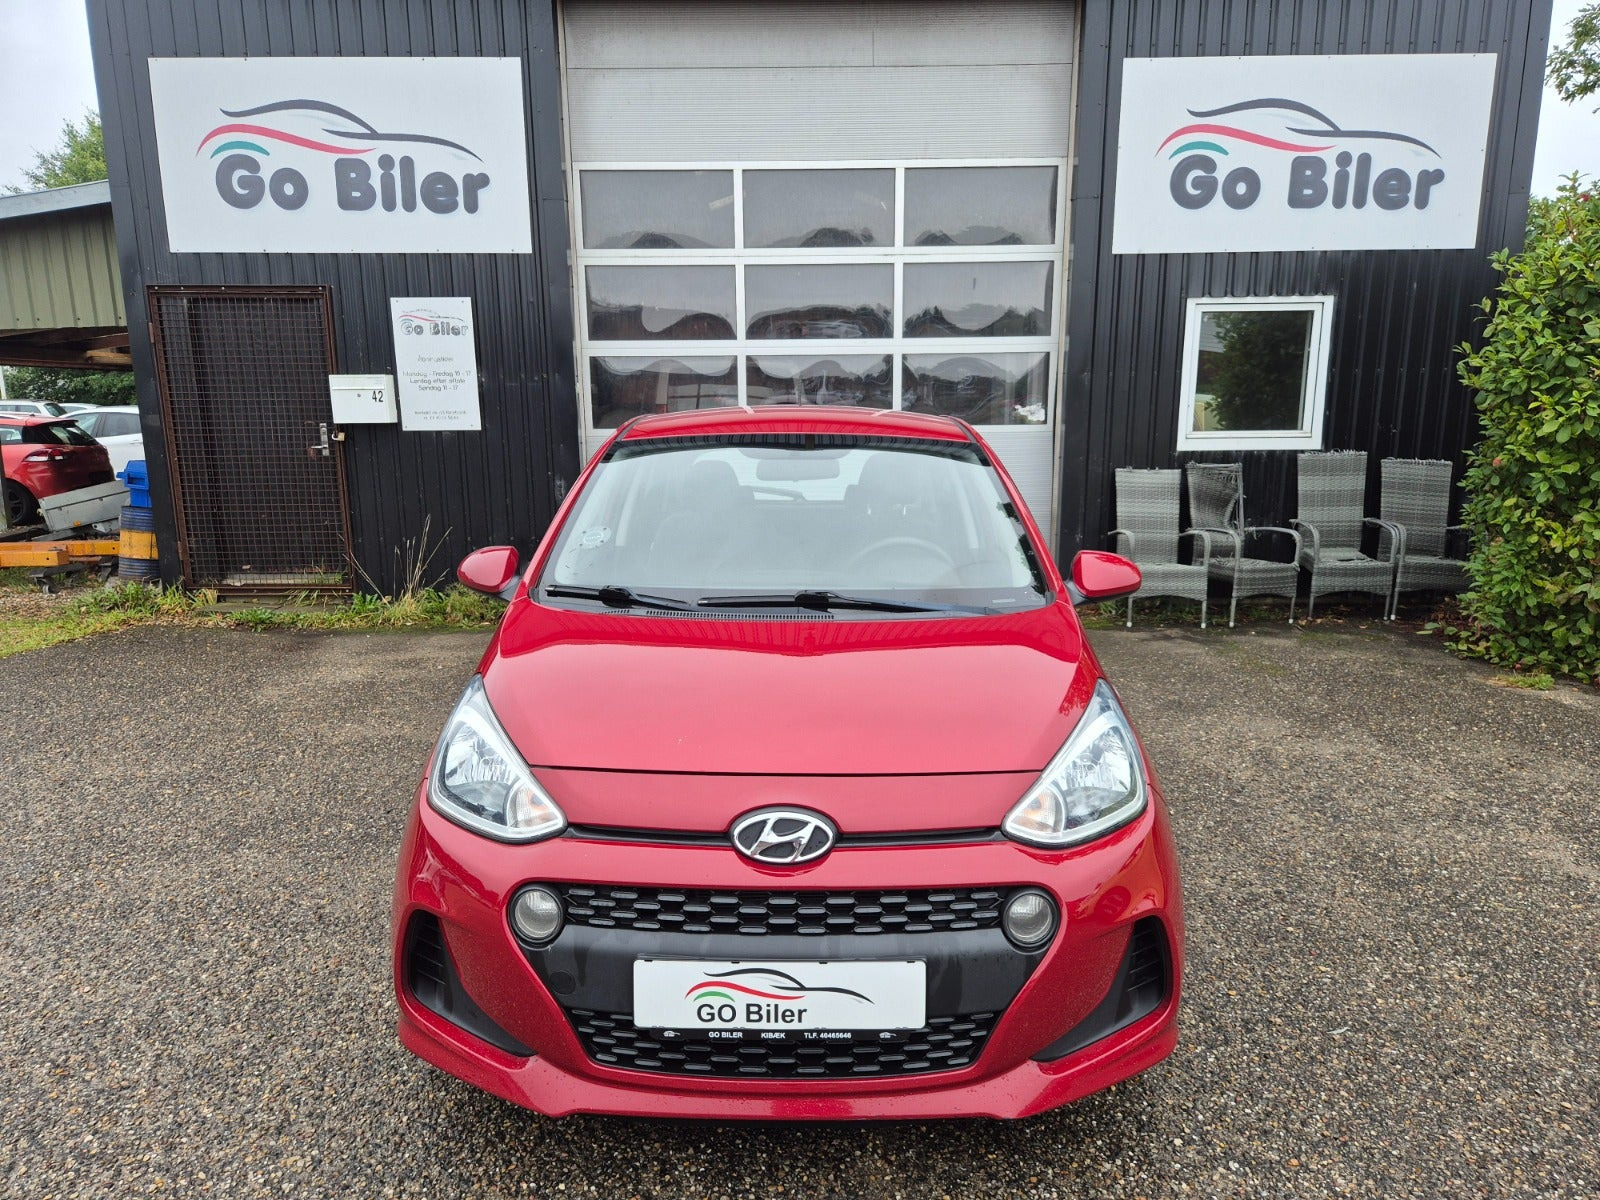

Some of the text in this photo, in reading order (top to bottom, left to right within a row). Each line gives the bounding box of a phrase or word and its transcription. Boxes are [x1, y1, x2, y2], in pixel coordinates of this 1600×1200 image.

[215, 153, 490, 215] Go Biler
[1169, 150, 1445, 211] Go Biler
[401, 321, 468, 336] Go Biler
[371, 390, 384, 403] 42
[696, 1003, 807, 1024] GO Biler
